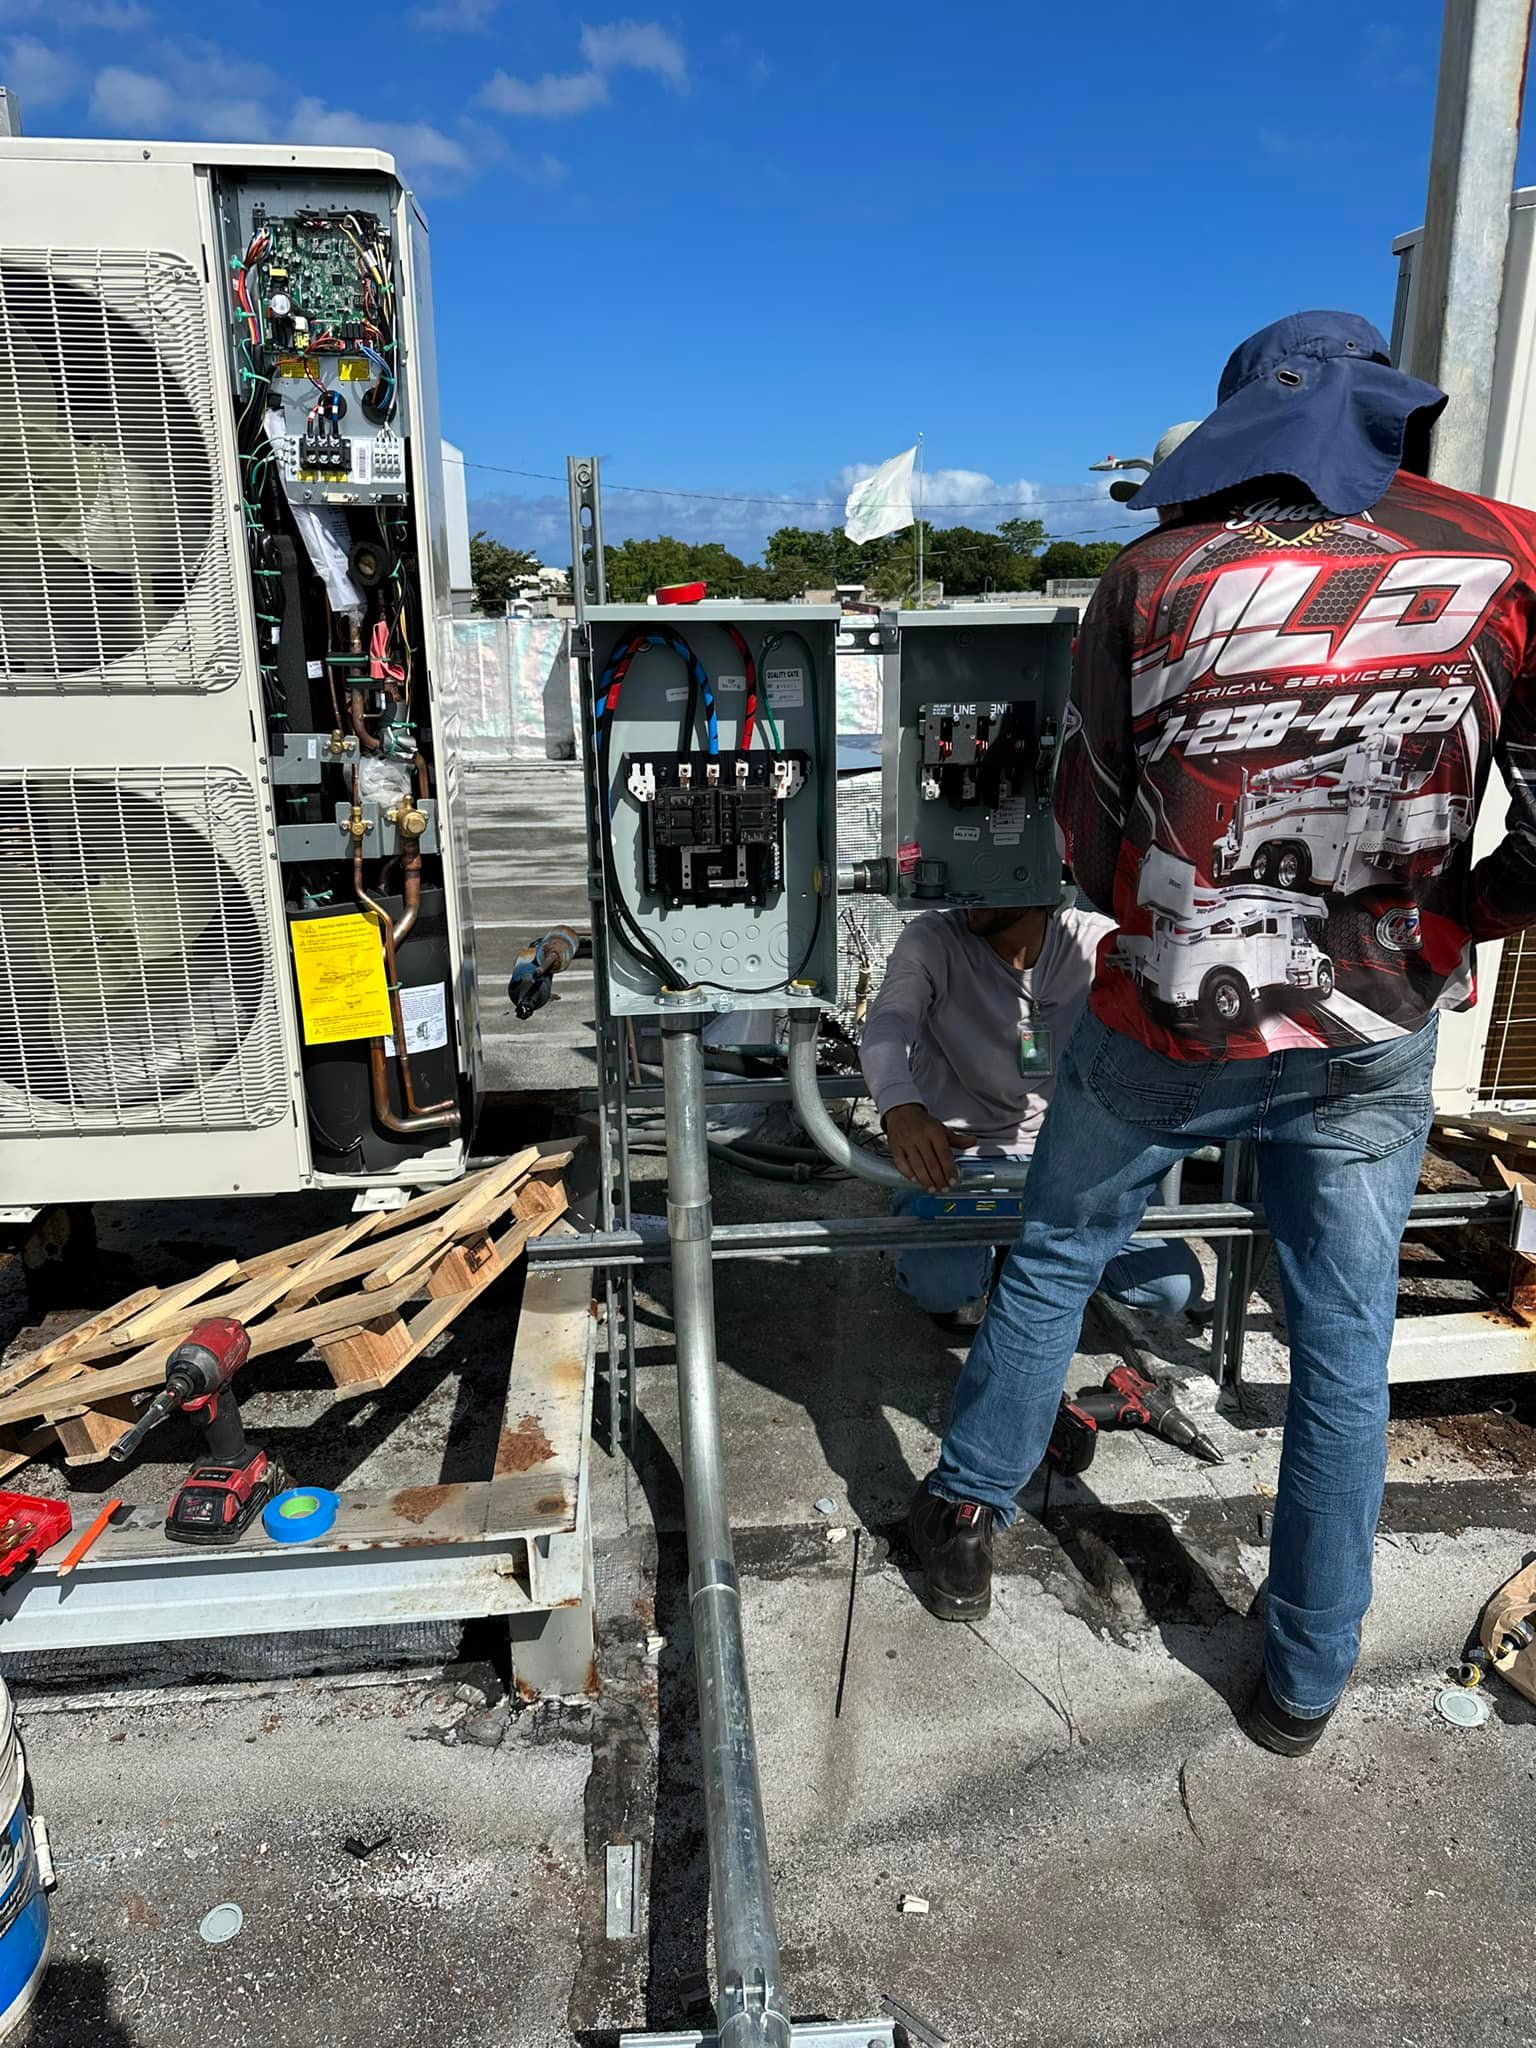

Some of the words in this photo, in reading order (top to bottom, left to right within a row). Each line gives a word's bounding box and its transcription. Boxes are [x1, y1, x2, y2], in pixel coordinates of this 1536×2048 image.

[1131, 556, 1513, 718] JLD
[787, 670, 799, 678] GATE
[1430, 664, 1474, 677] INC.
[953, 704, 977, 715] LINE
